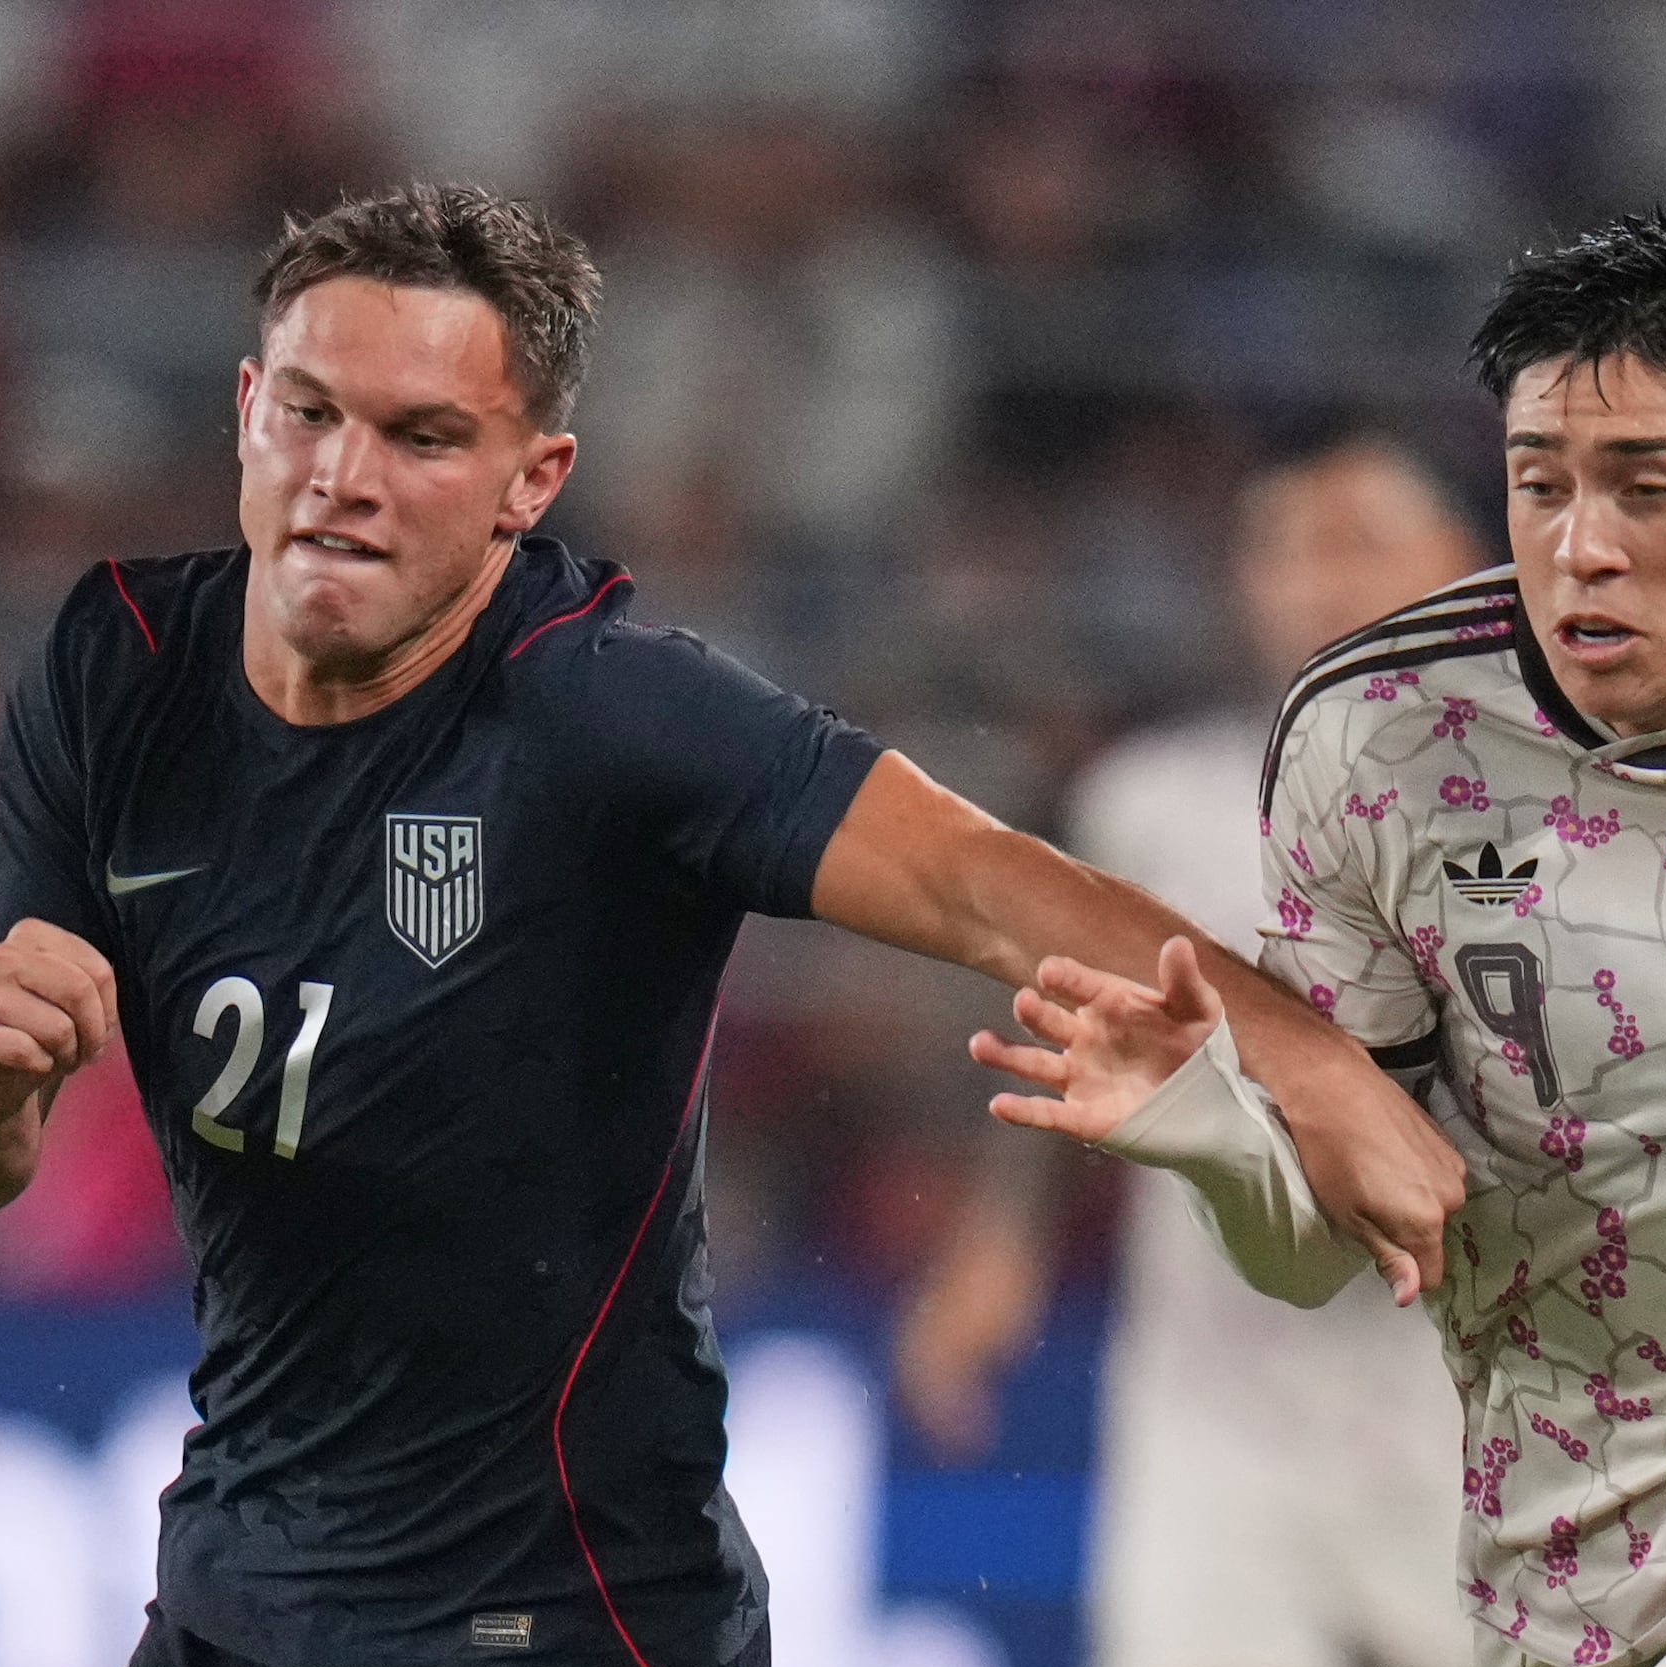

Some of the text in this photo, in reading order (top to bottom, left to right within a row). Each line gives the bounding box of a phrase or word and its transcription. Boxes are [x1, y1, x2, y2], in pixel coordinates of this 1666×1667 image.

[394, 823, 475, 881] USA
[191, 975, 334, 1161] 21
[1453, 941, 1565, 1113] 9
